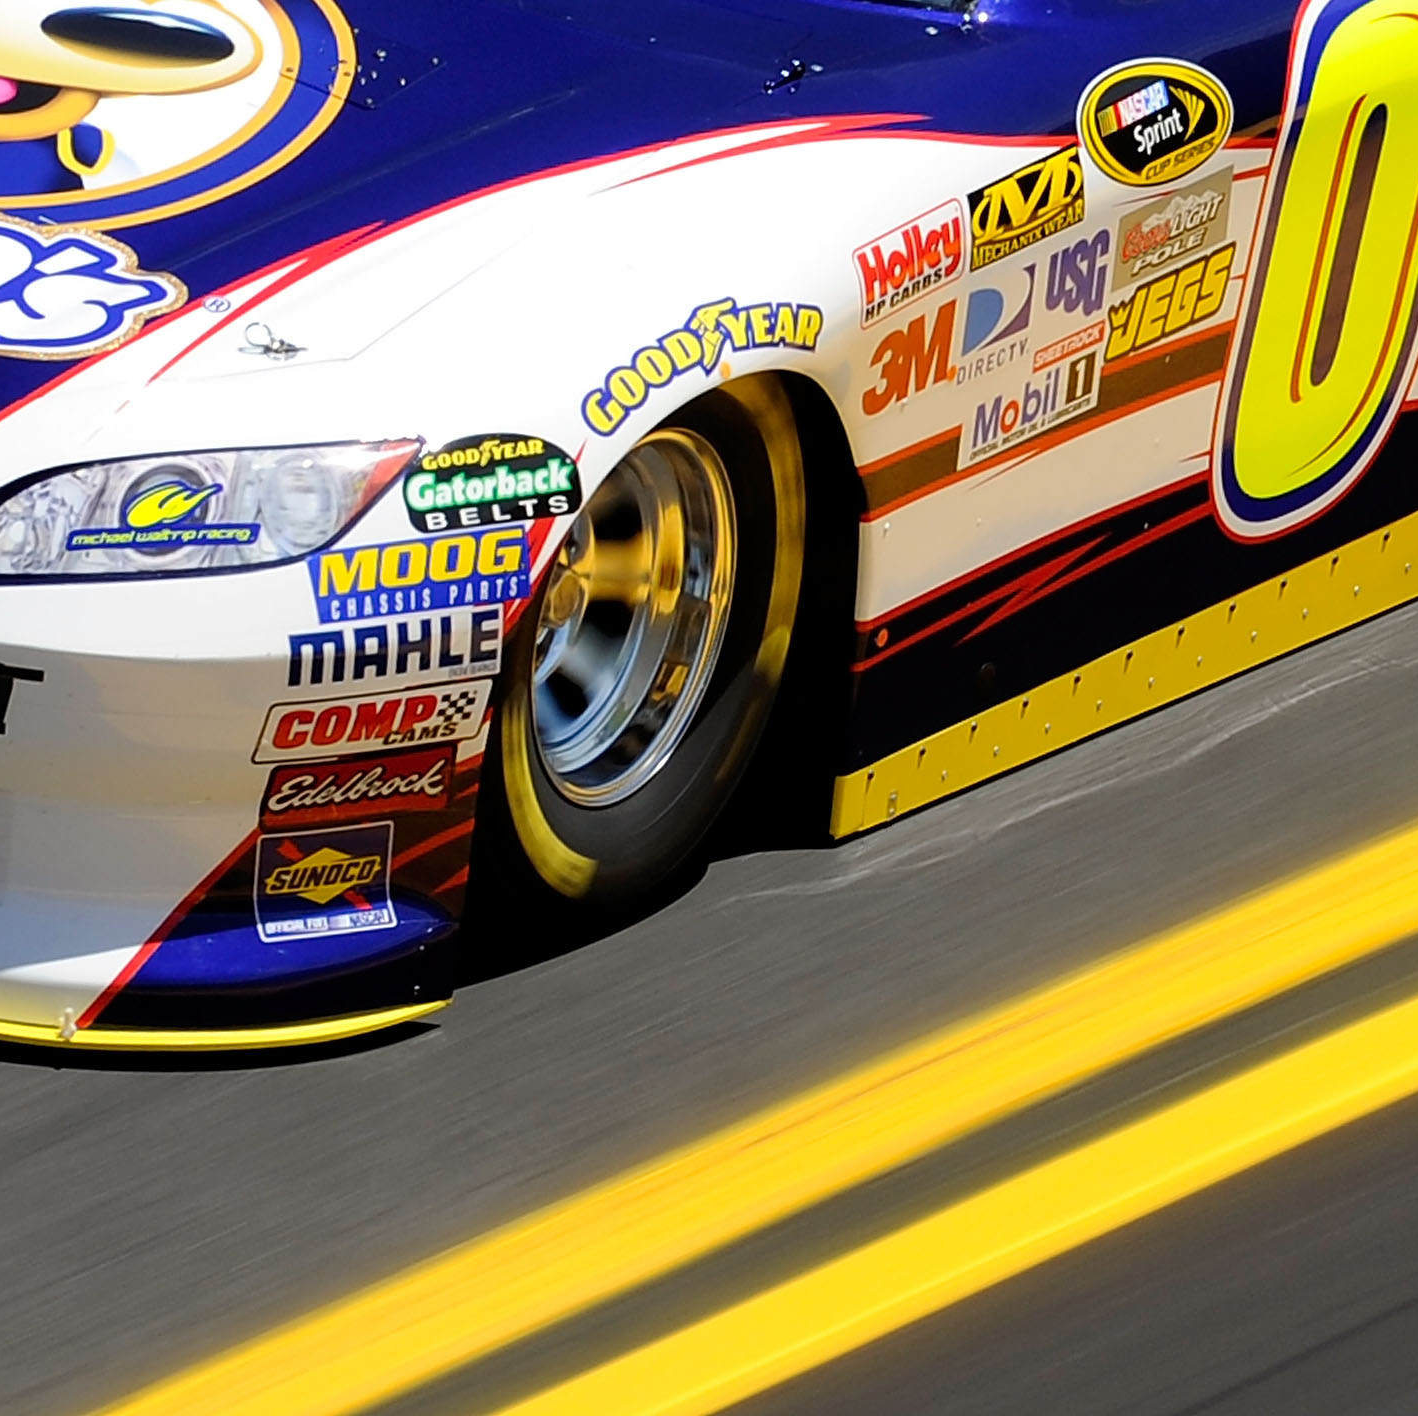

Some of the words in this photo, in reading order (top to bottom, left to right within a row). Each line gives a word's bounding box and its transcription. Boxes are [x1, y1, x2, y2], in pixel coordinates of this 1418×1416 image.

[1133, 108, 1184, 155] Sprint
[1145, 158, 1171, 180] CUP
[1174, 137, 1215, 166] SERIES
[972, 227, 1042, 267] MECHANIX
[1044, 198, 1084, 236] WEAR
[1170, 194, 1224, 237] LIGHT
[857, 216, 961, 305] Holley
[1046, 229, 1110, 316] USG
[1131, 230, 1206, 276] POLE
[865, 302, 886, 322] HP
[889, 267, 942, 308] CARBS
[1104, 244, 1236, 362] JEGS
[862, 298, 957, 416] 3M
[957, 337, 1028, 385] DIRECTV
[972, 367, 1061, 449] Mobil
[406, 460, 574, 511] Gatorback
[72, 531, 134, 545] michael
[135, 528, 196, 543] waltrip
[198, 528, 252, 542] racing
[426, 496, 570, 529] BELTS
[318, 529, 523, 596] MOOG
[330, 590, 431, 620] CHASSIS
[449, 578, 519, 605] PARTS
[288, 610, 500, 686] MAHLE
[272, 695, 438, 749] COMP
[383, 722, 459, 745] CAMS
[267, 759, 446, 811] Edelbrock
[268, 859, 379, 891] SUNOCO
